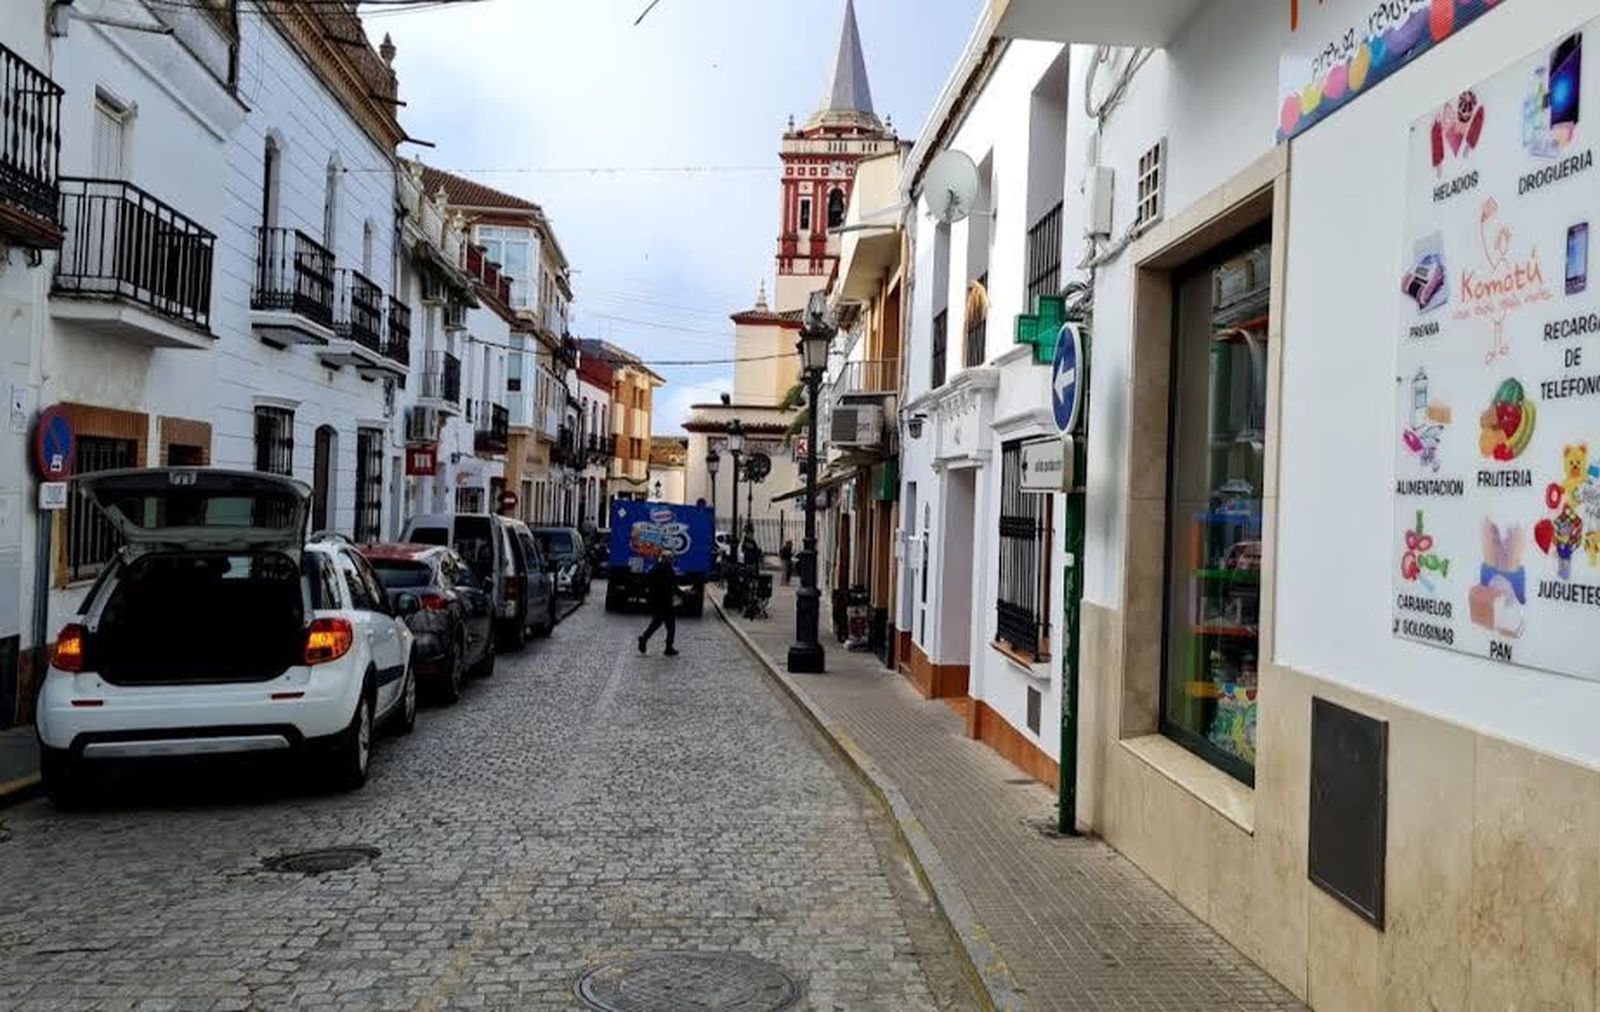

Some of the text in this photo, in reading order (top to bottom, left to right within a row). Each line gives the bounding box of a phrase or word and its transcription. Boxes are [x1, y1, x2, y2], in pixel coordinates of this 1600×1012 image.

[1518, 149, 1593, 195] DROGUERIA
[1432, 170, 1479, 203] HELADOS
[1543, 313, 1600, 341] RECARG
[1564, 347, 1582, 368] DE
[1537, 580, 1600, 606] JUGUETES
[1396, 594, 1453, 619] CARAMELOS
[1489, 641, 1513, 662] PAN
